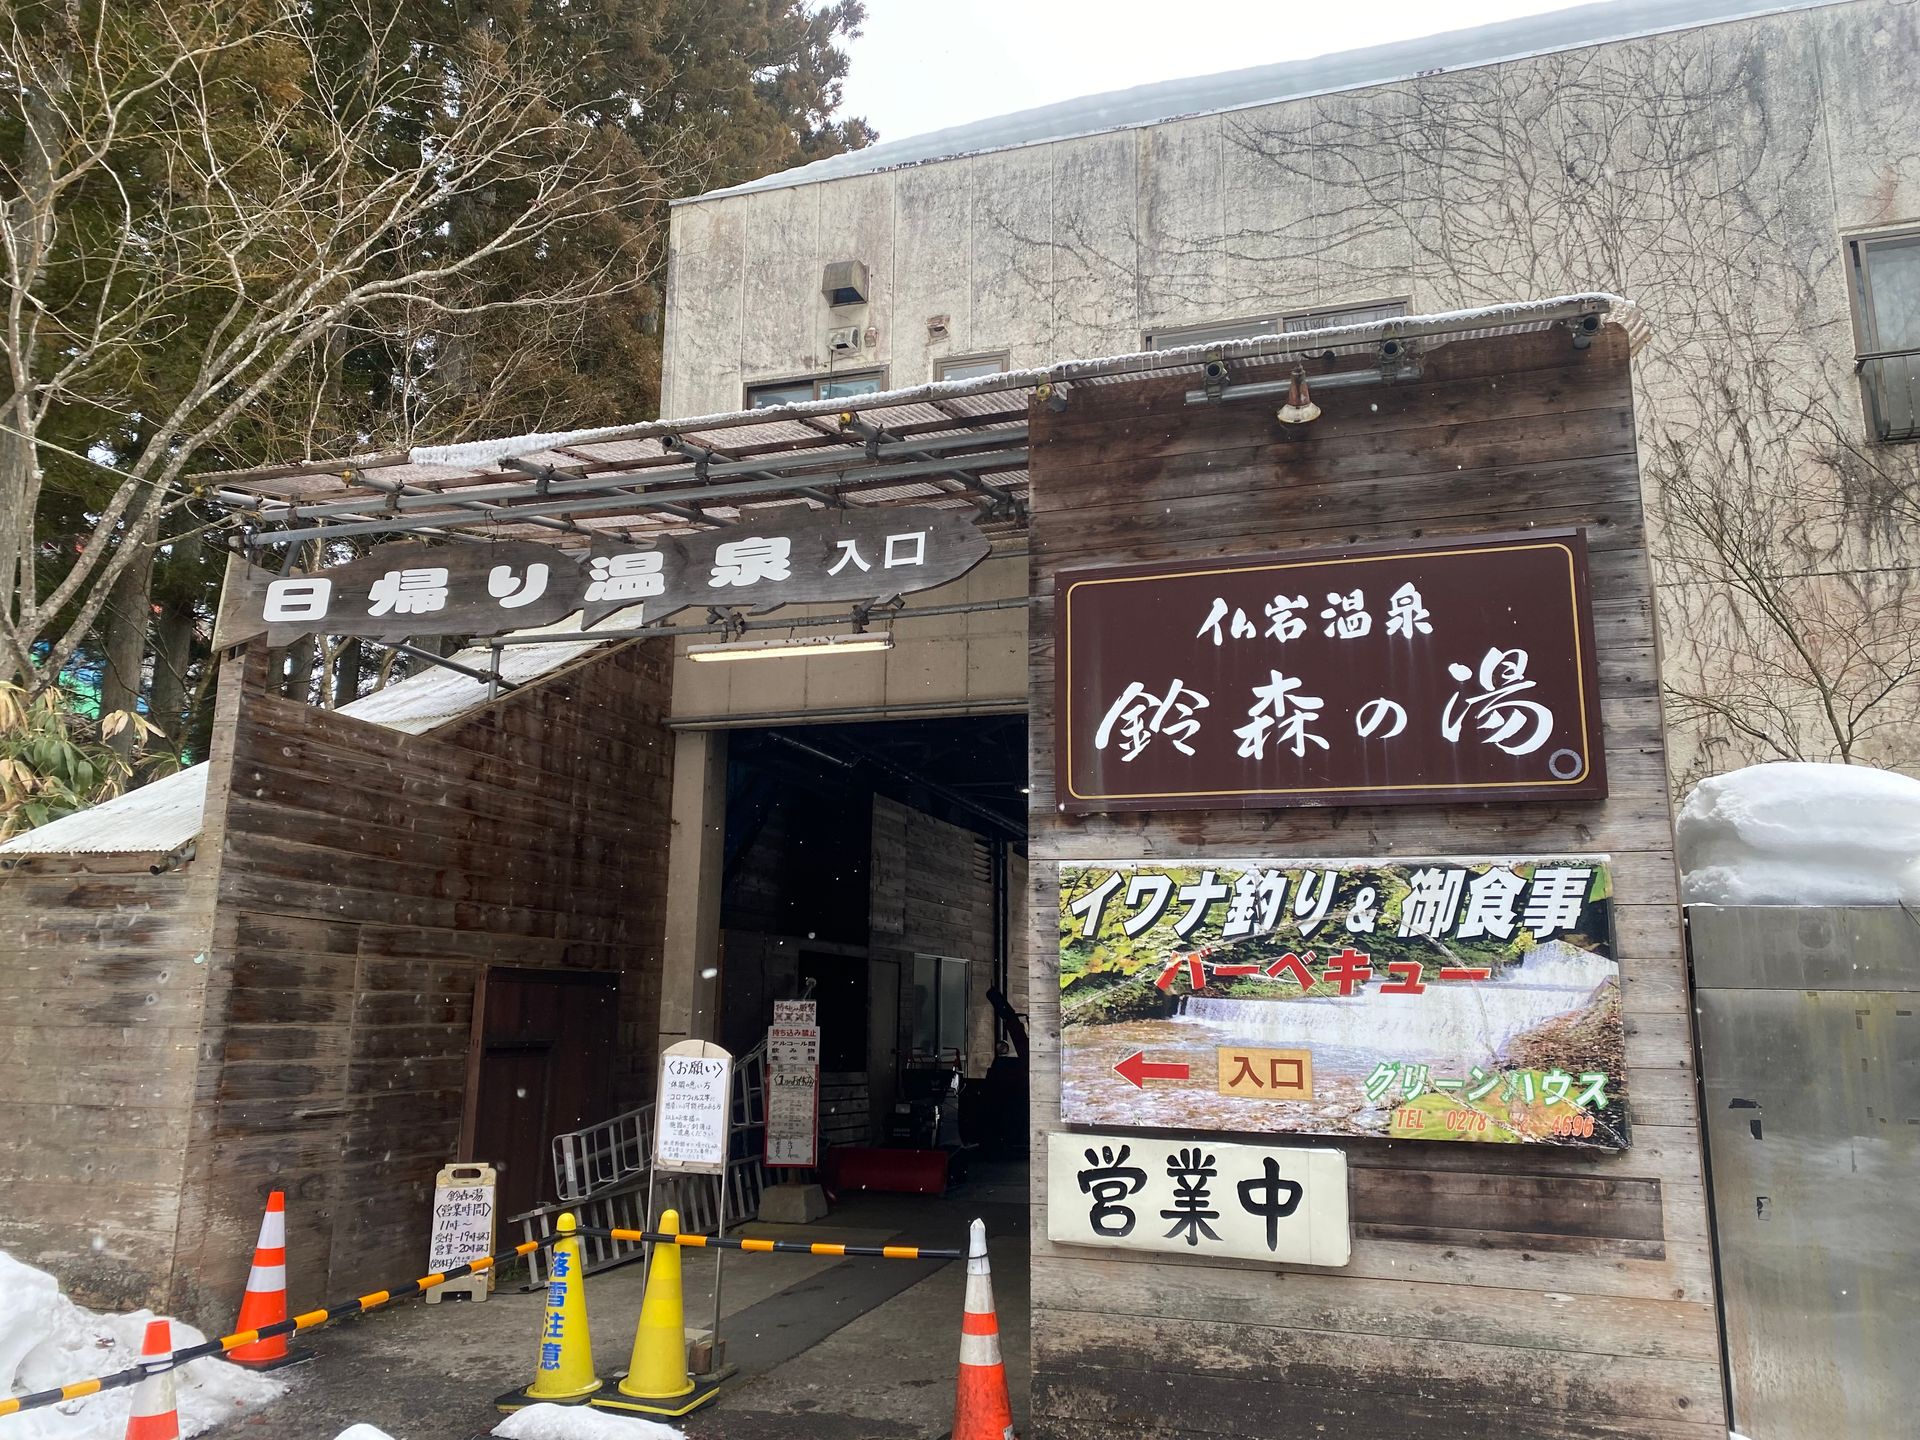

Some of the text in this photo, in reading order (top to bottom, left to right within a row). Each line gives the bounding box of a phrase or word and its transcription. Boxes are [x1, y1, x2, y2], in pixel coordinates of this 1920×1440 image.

[262, 531, 925, 623] 日帰り温泉 入口
[1196, 581, 1434, 646] 仏岩温泉
[1095, 646, 1555, 762] 鈴森の湯
[1154, 948, 1492, 996] バーベキュー
[772, 1029, 817, 1037] 持ち込み禁止
[1227, 1055, 1305, 1091] 入口
[1364, 1060, 1610, 1110] グリーンハウス
[1396, 1107, 1425, 1129] TEL
[1076, 1145, 1304, 1253] 営業中
[540, 1251, 571, 1371] 落雪注意
